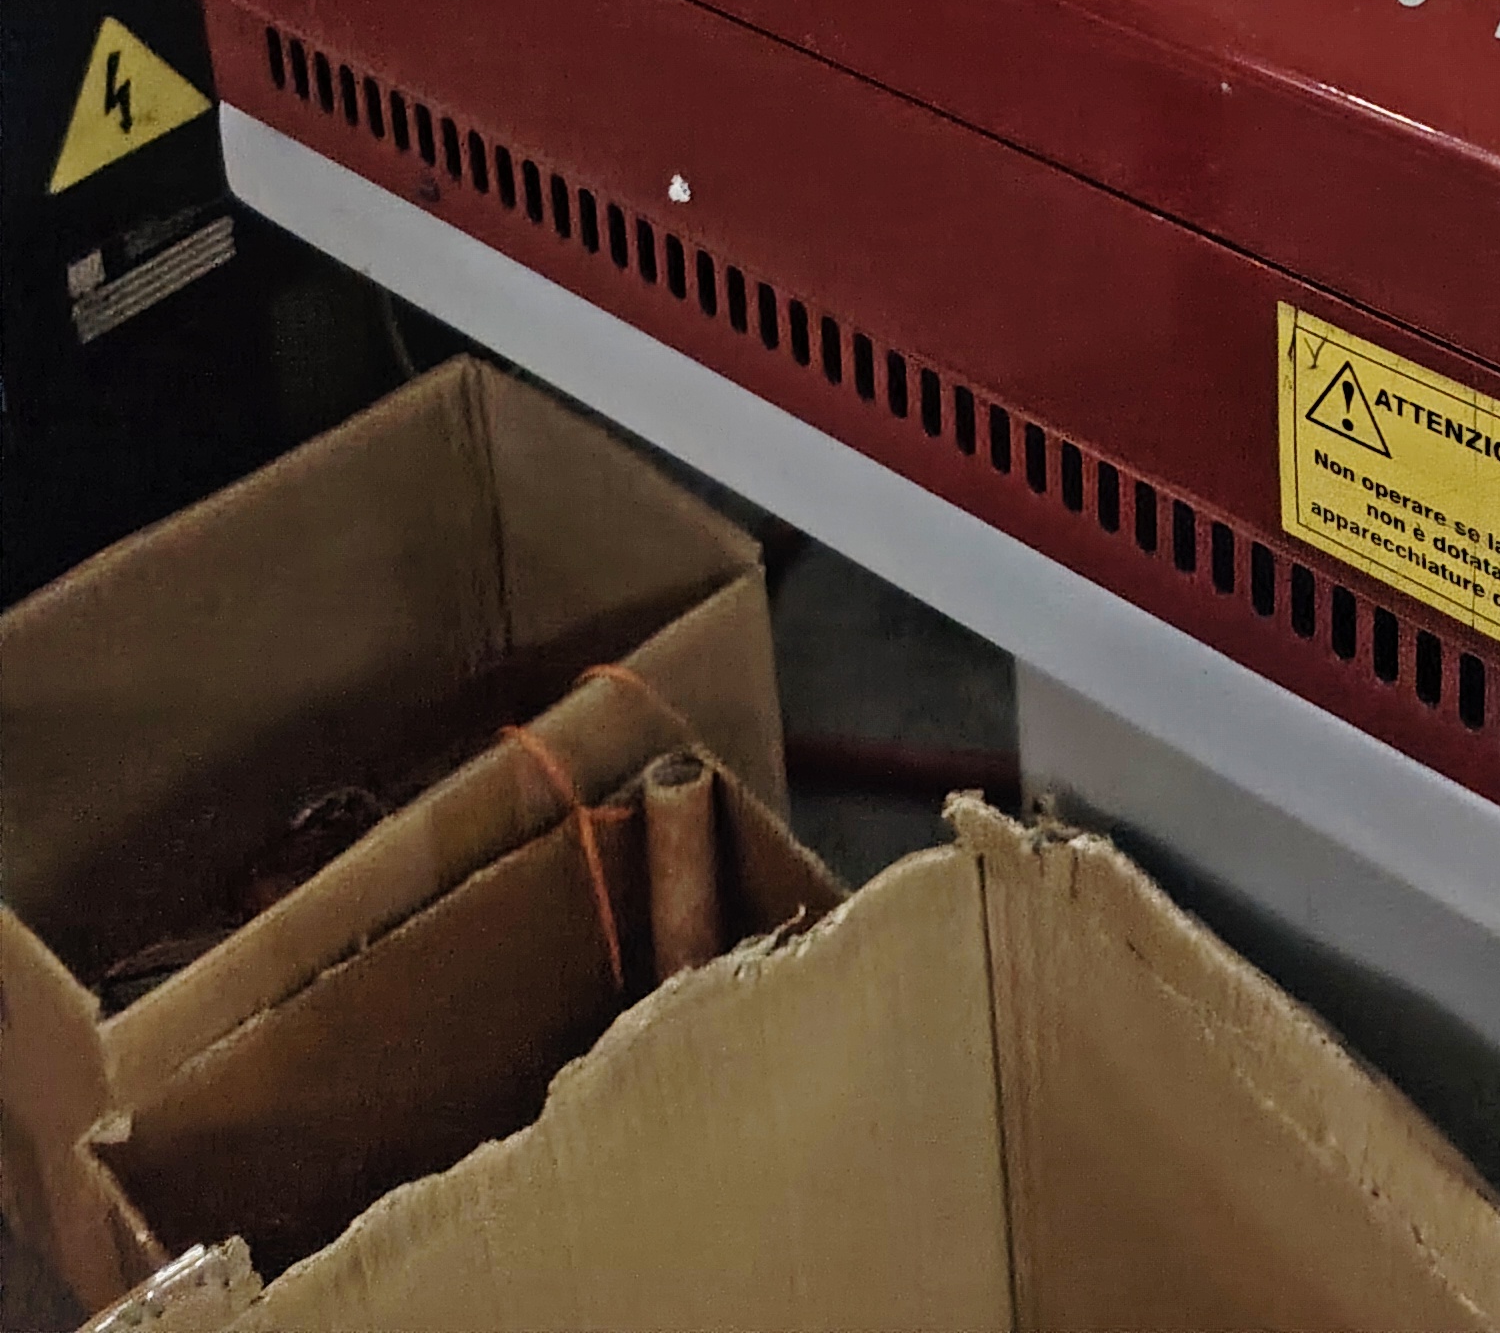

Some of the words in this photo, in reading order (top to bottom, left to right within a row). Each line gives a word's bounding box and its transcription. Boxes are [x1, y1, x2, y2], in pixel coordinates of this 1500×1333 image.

[1313, 448, 1356, 484] Non
[1361, 474, 1447, 528] operare
[1454, 520, 1481, 544] se
[1366, 502, 1407, 535] non
[1412, 520, 1427, 543] è
[1310, 501, 1486, 599] apparecchiature
